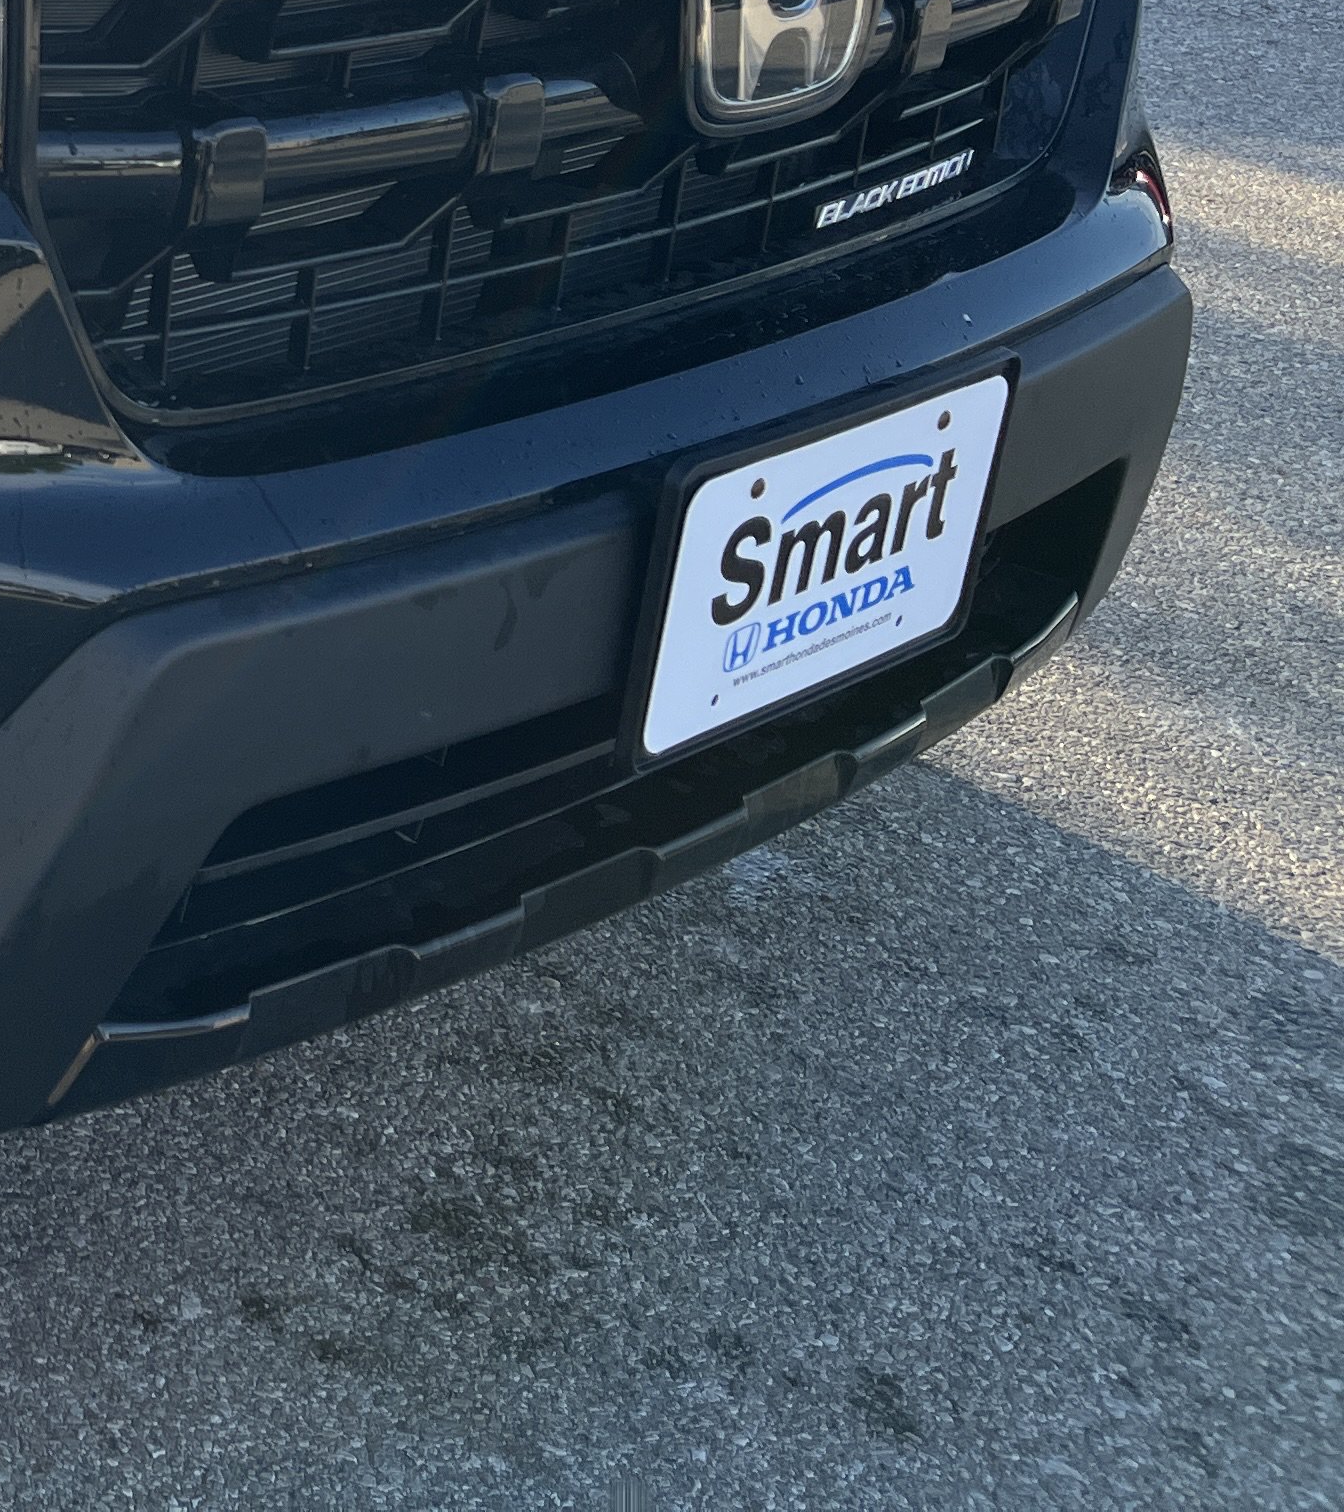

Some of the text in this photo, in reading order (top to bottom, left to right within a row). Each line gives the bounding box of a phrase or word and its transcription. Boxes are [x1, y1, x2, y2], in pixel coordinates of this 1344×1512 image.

[816, 180, 899, 229] BLACK
[711, 447, 959, 627] Smart
[732, 612, 892, 687] www.smarthondadesmoines.com
[762, 565, 915, 653] HONDA
